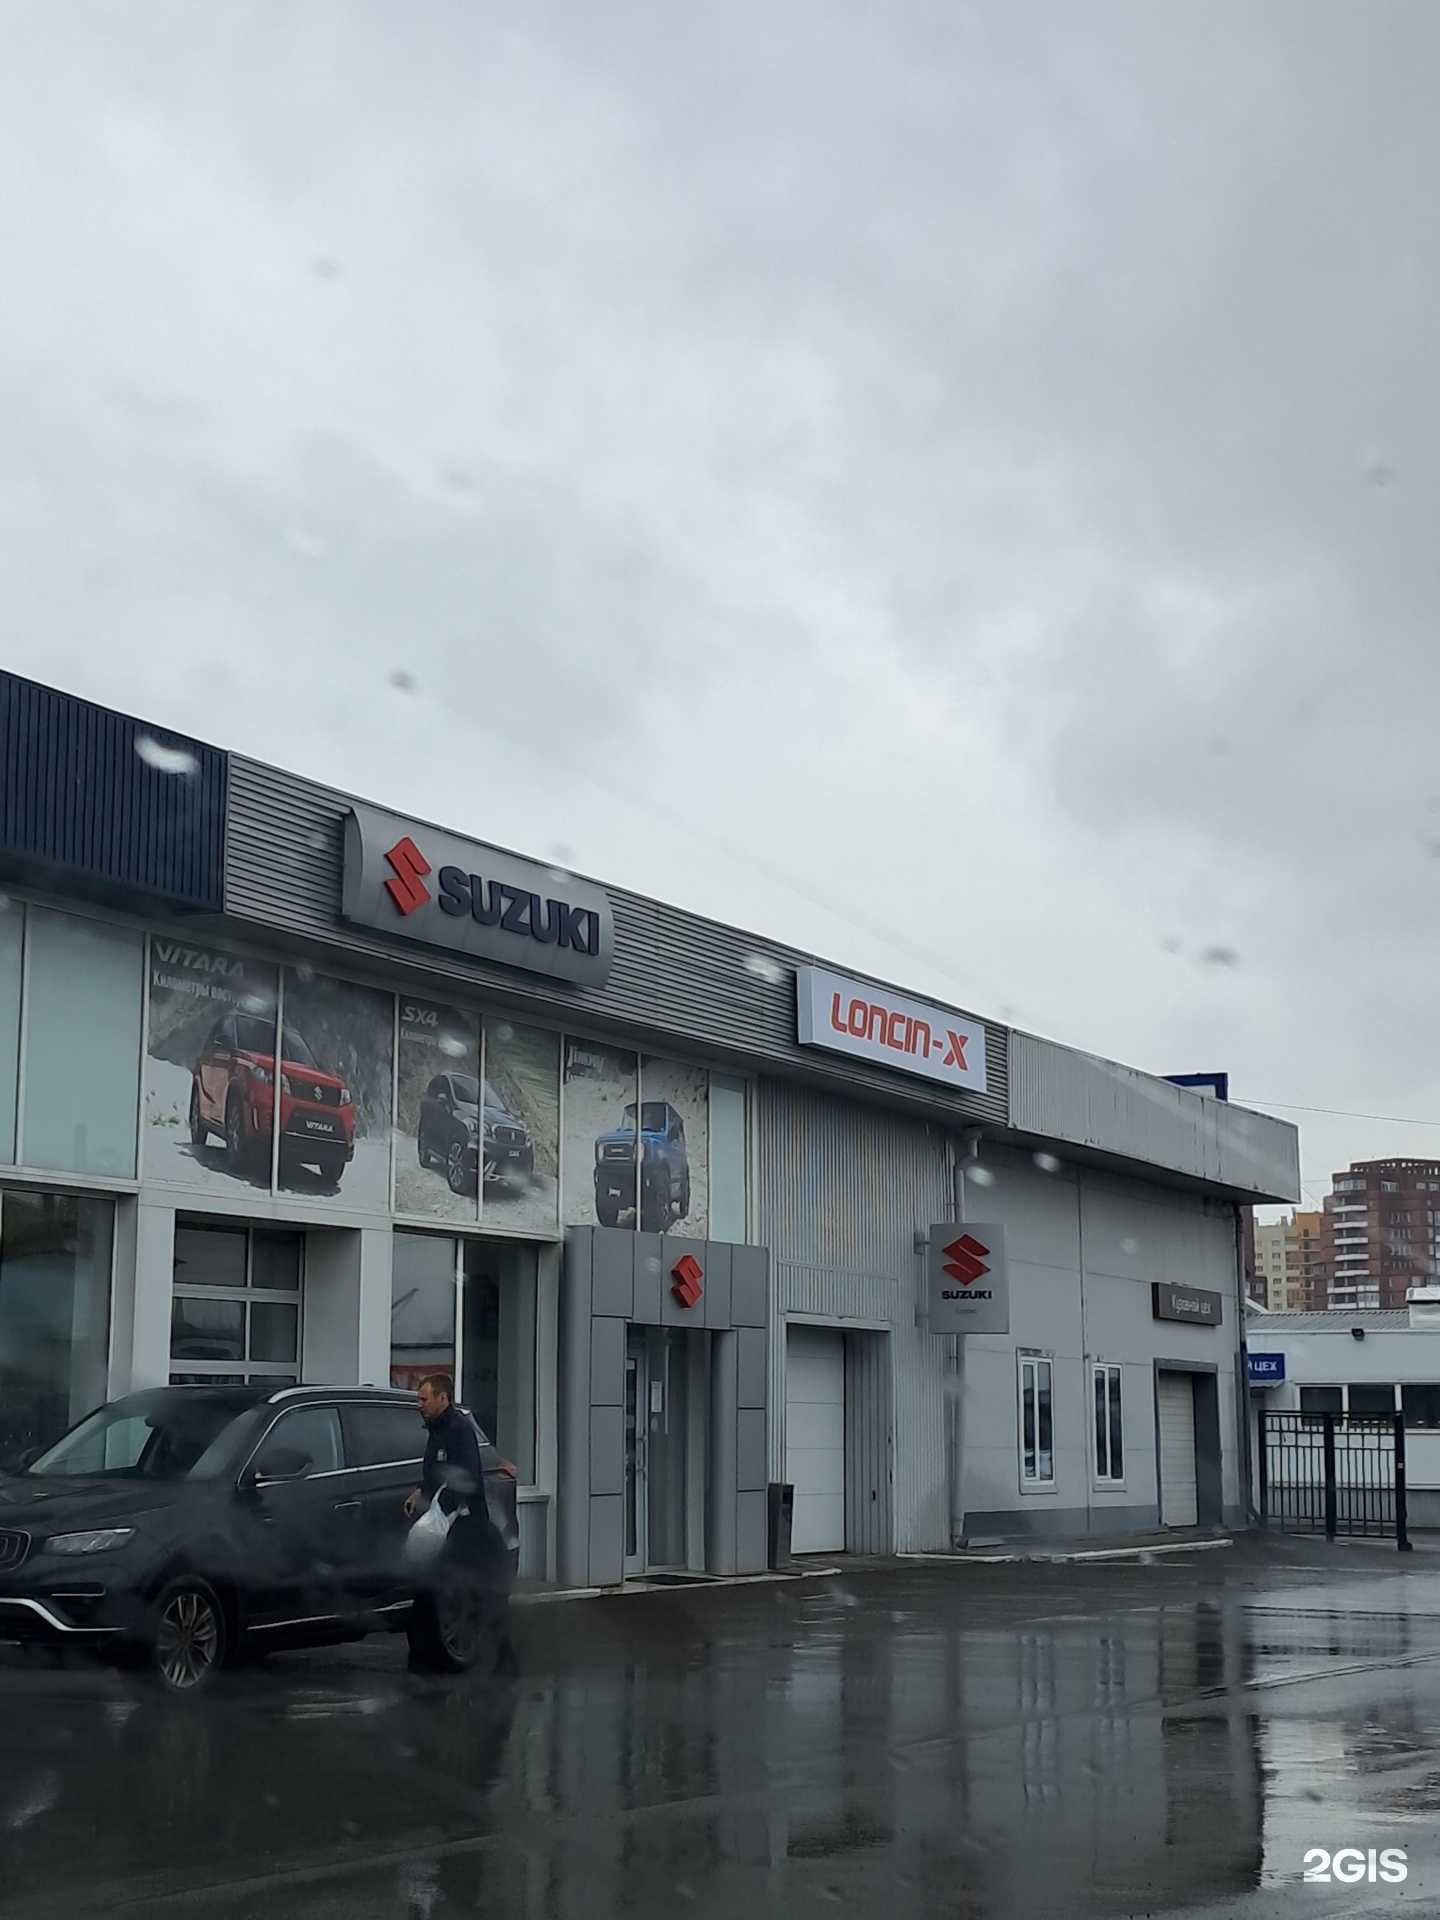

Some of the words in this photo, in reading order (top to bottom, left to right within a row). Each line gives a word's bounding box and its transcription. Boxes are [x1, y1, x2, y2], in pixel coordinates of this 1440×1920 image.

[438, 866, 600, 956] SUZUKI
[154, 942, 245, 977] VITARA
[401, 1006, 439, 1027] SX4
[942, 1290, 992, 1300] SUZUKI
